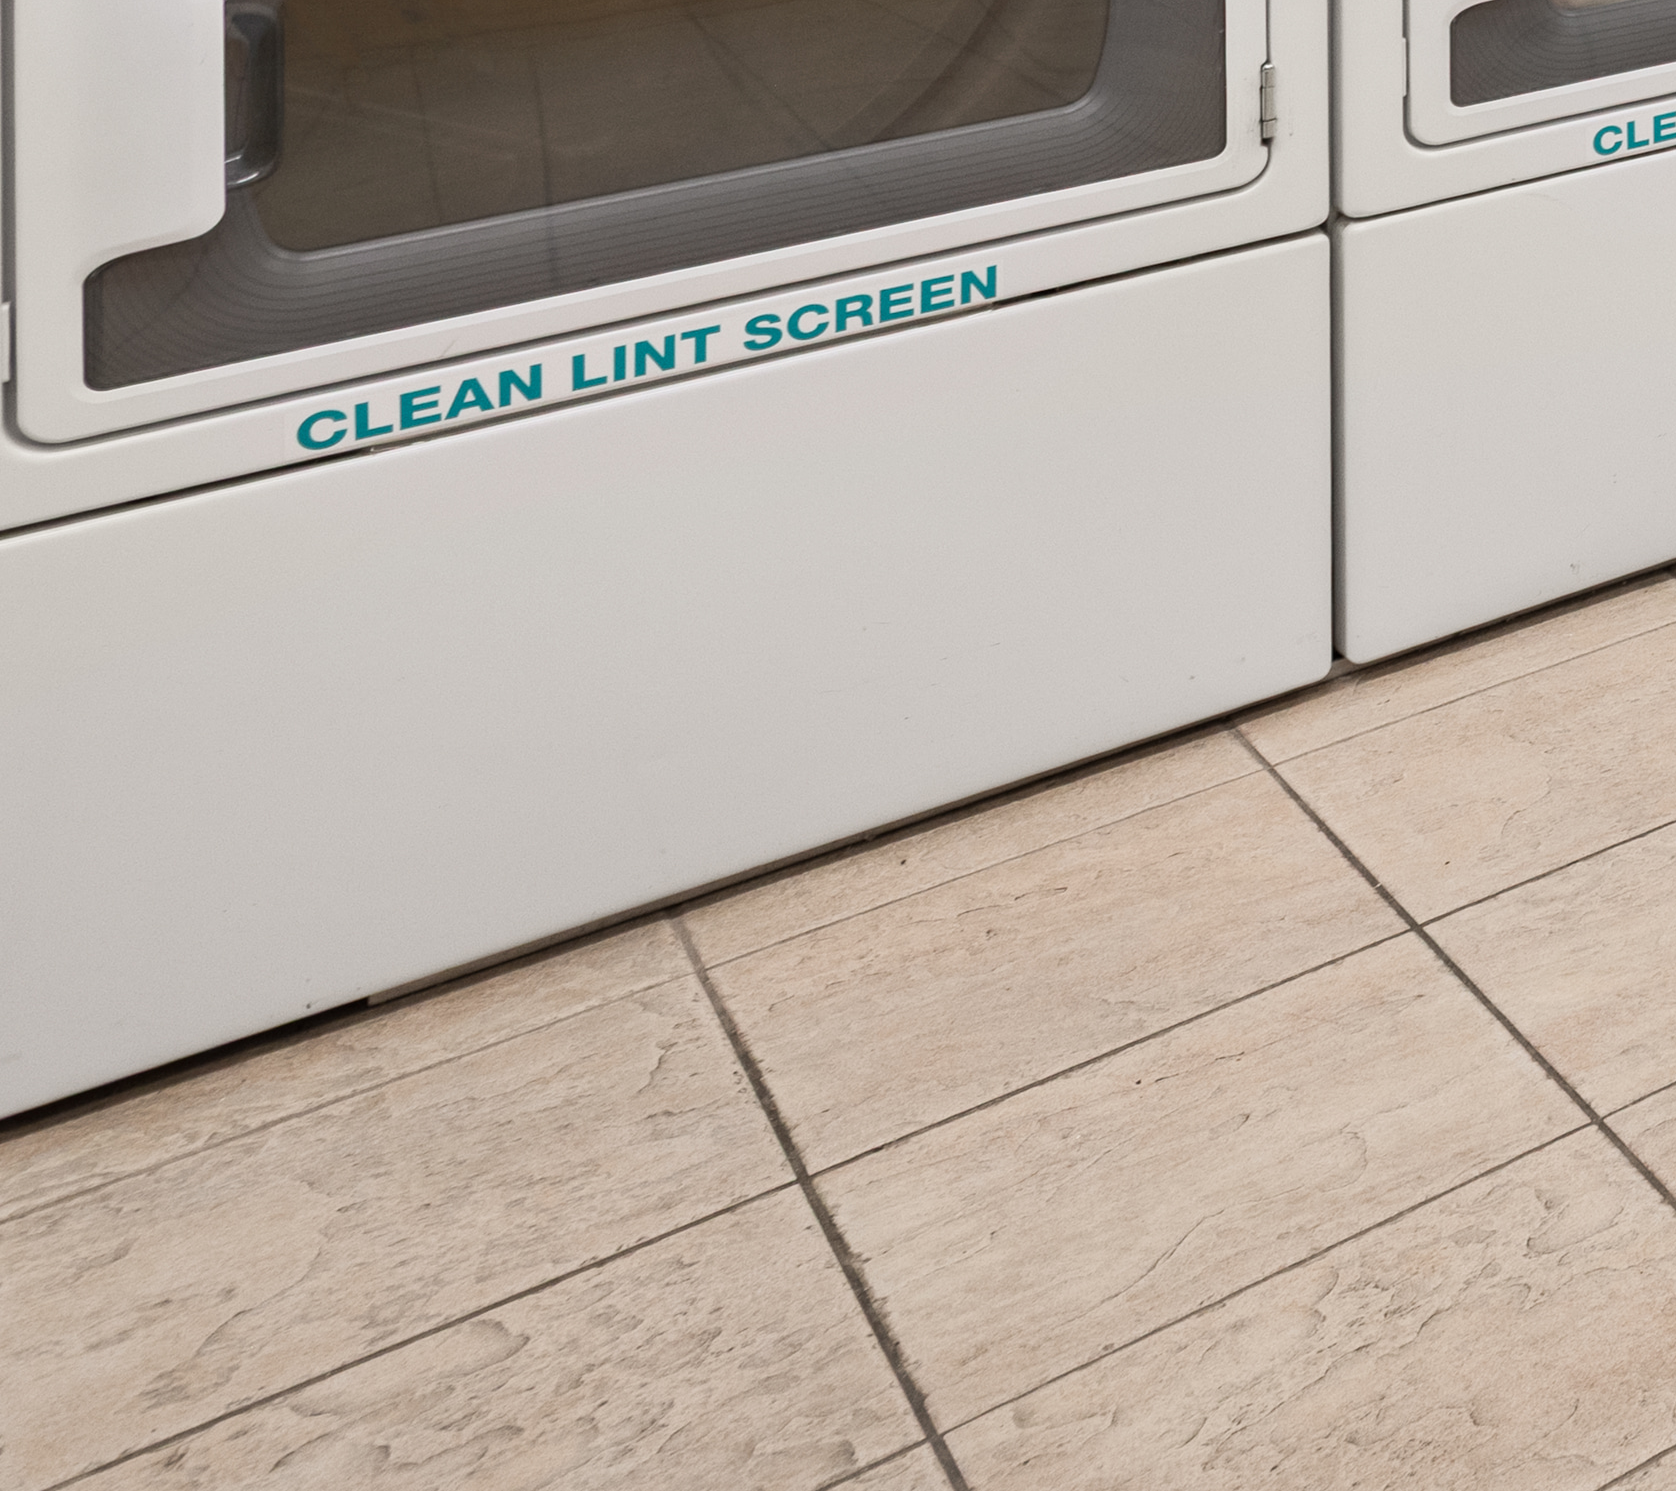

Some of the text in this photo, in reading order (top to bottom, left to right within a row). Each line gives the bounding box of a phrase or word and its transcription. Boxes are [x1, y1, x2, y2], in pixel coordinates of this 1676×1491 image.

[295, 265, 1000, 452] CLEAN LINT SCREEN
